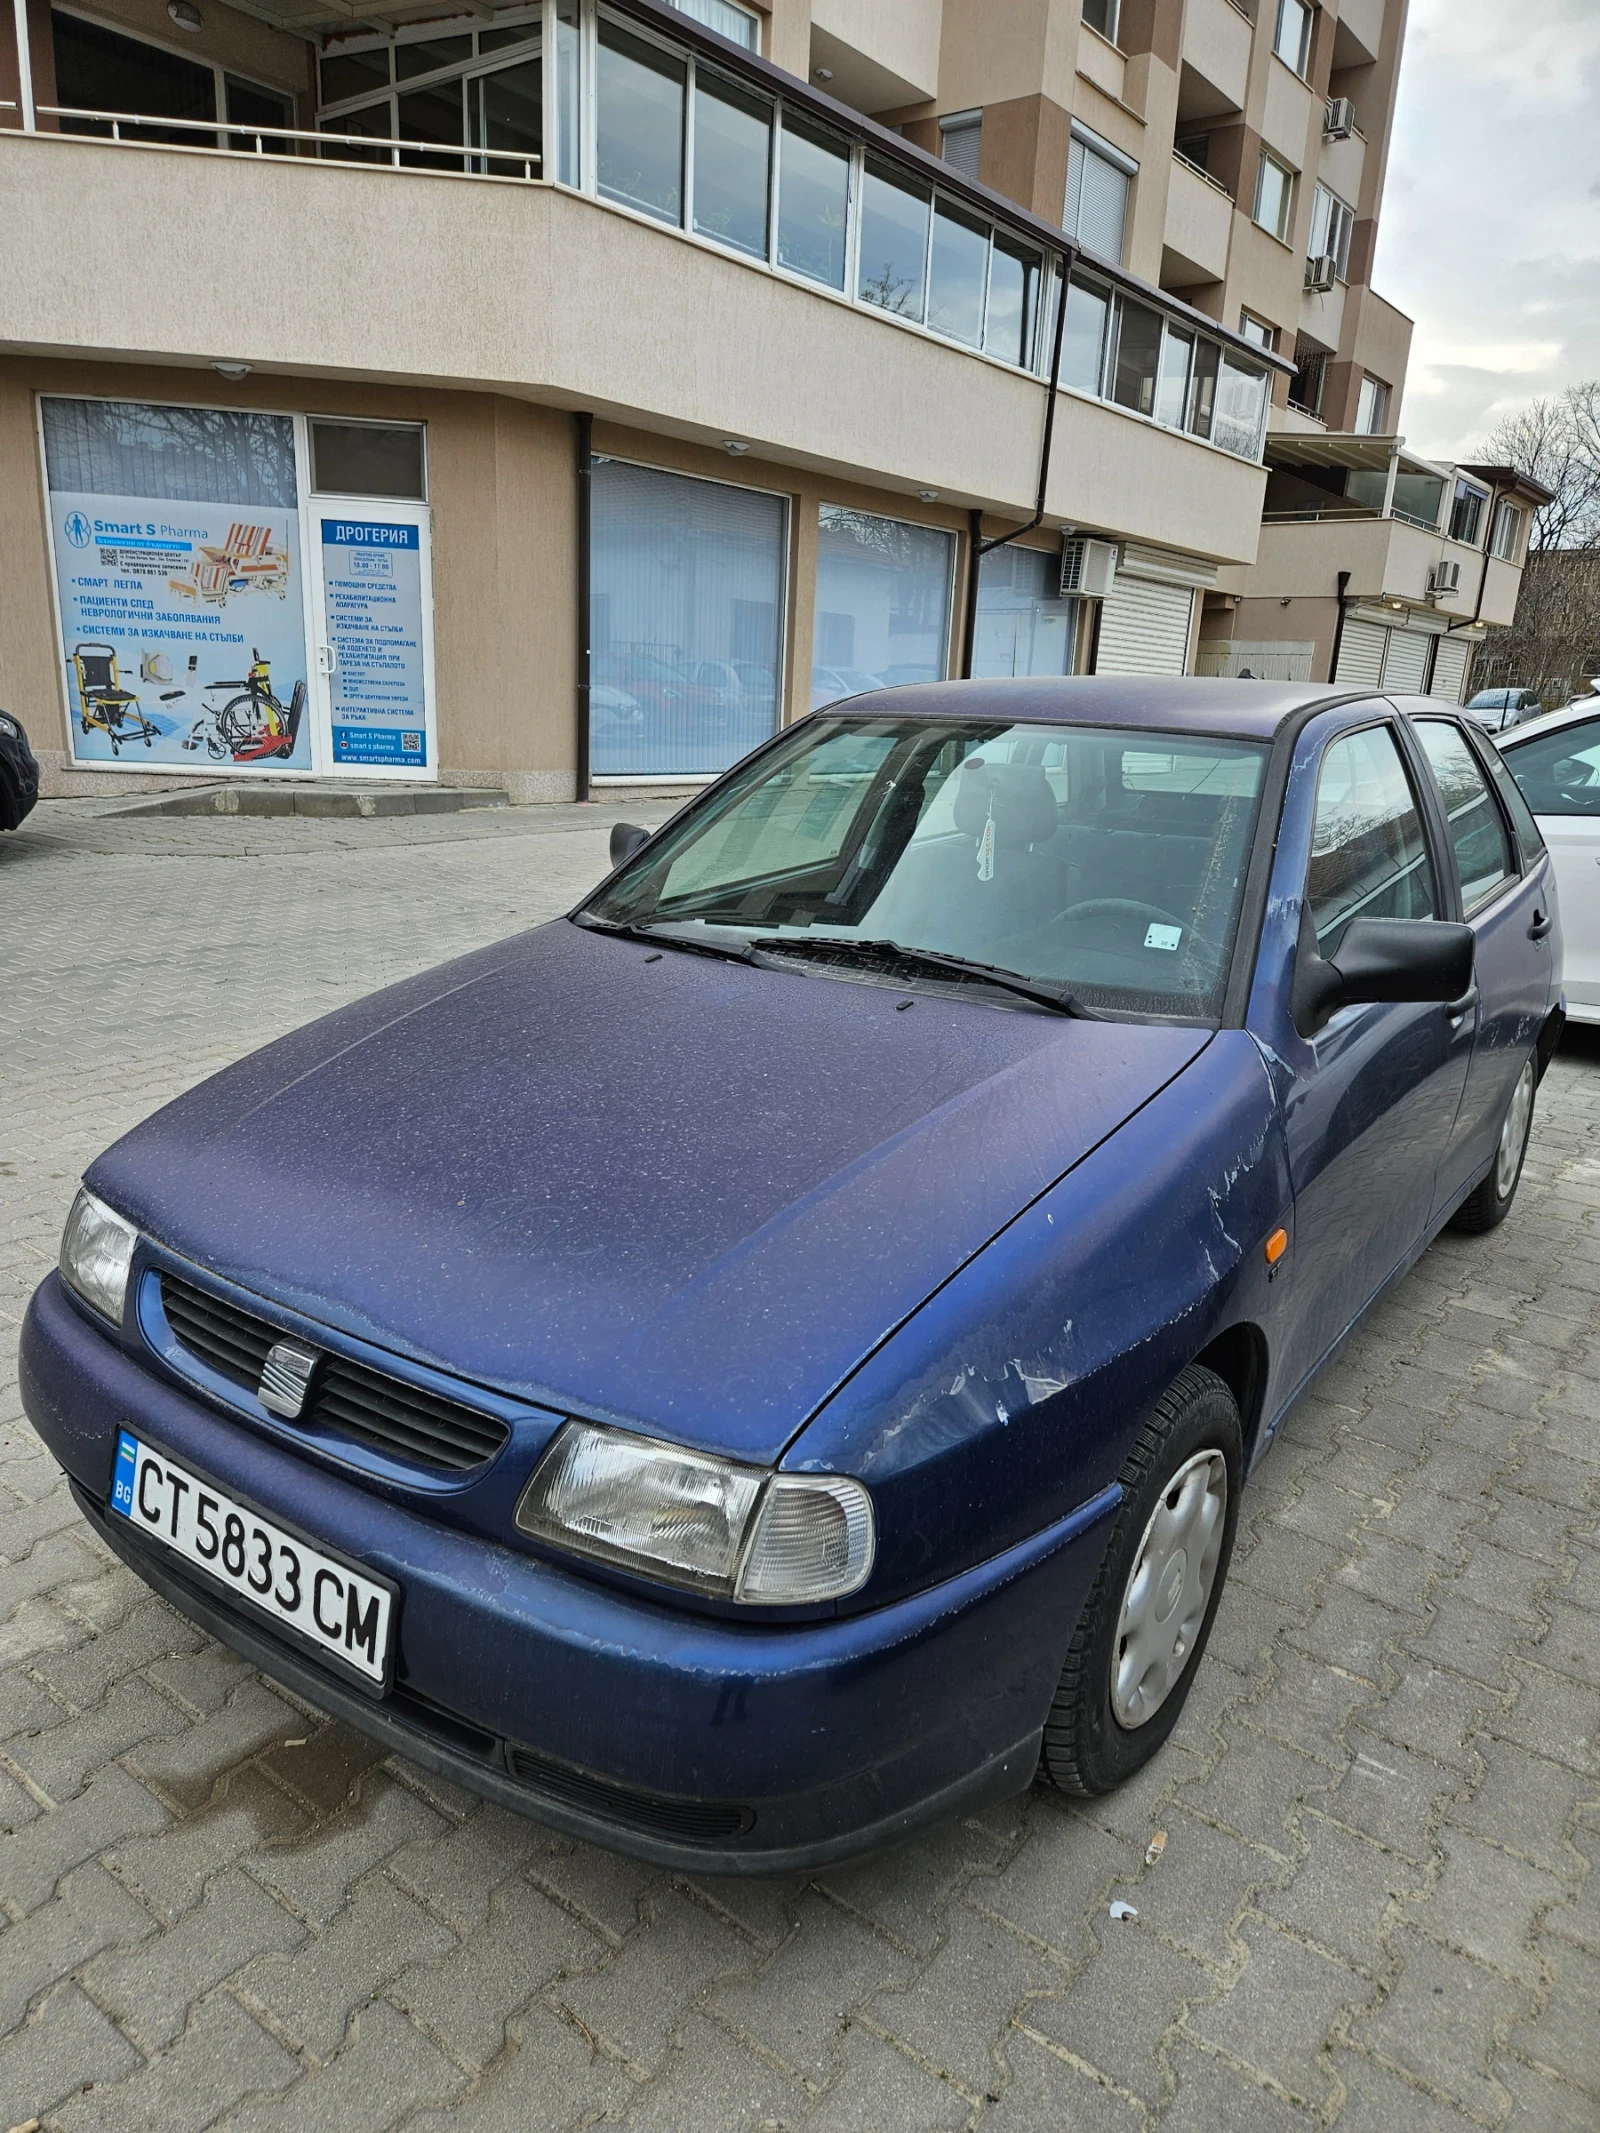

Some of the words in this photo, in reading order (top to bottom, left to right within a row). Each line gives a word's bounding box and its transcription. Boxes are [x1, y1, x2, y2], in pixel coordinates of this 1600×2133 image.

[94, 520, 143, 535] Smart
[146, 523, 156, 535] S
[160, 525, 208, 539] Pharma
[335, 525, 408, 544] ДРОГЕРИЯ
[78, 577, 109, 589] СМАРТ
[113, 580, 143, 591] ЛЕГЛА
[335, 581, 366, 589] ПОМОЩНИ
[367, 583, 397, 591] СРЕДСТВА
[79, 595, 128, 609] ПАЦИЕНТИ
[130, 598, 154, 610] СЛЕД
[335, 593, 397, 603] РЕХАБИЛИТАЦИОННА
[336, 601, 369, 609] АПАРАТУРА
[81, 607, 153, 622] НЕВРОЛОГИЧНИ
[155, 612, 221, 625] ЗАБОЛЯВАНИЯ
[336, 615, 363, 623] СИСТЕМИ
[336, 623, 370, 631] ИЗКАЧВАНЕ
[380, 625, 404, 633] СТЪЛБИ
[82, 625, 126, 638] СИСТЕМИ
[127, 627, 140, 639] ЗА
[141, 628, 193, 641] ИЗКАЧВАНЕ
[195, 631, 208, 643] НА
[209, 632, 244, 645] СТЪЛБИ
[337, 636, 364, 645] СИСТЕМА
[375, 639, 417, 648] ПОДПОМАГАНЕ
[347, 645, 376, 653] ХОДЕНЕТО
[338, 652, 387, 661] РЕХАБИЛИТАЦИЯ
[338, 659, 361, 667] ПАРЕЗА
[371, 662, 406, 670] СТЪПАЛОТО
[341, 706, 386, 715] ИНТЕРАКТИВНА
[373, 733, 396, 741] Pharma
[341, 755, 421, 764] www.smartspharma.com
[114, 1480, 132, 1507] BG
[138, 1458, 190, 1539] CT
[195, 1492, 302, 1612] 5833
[312, 1568, 381, 1665] CM
